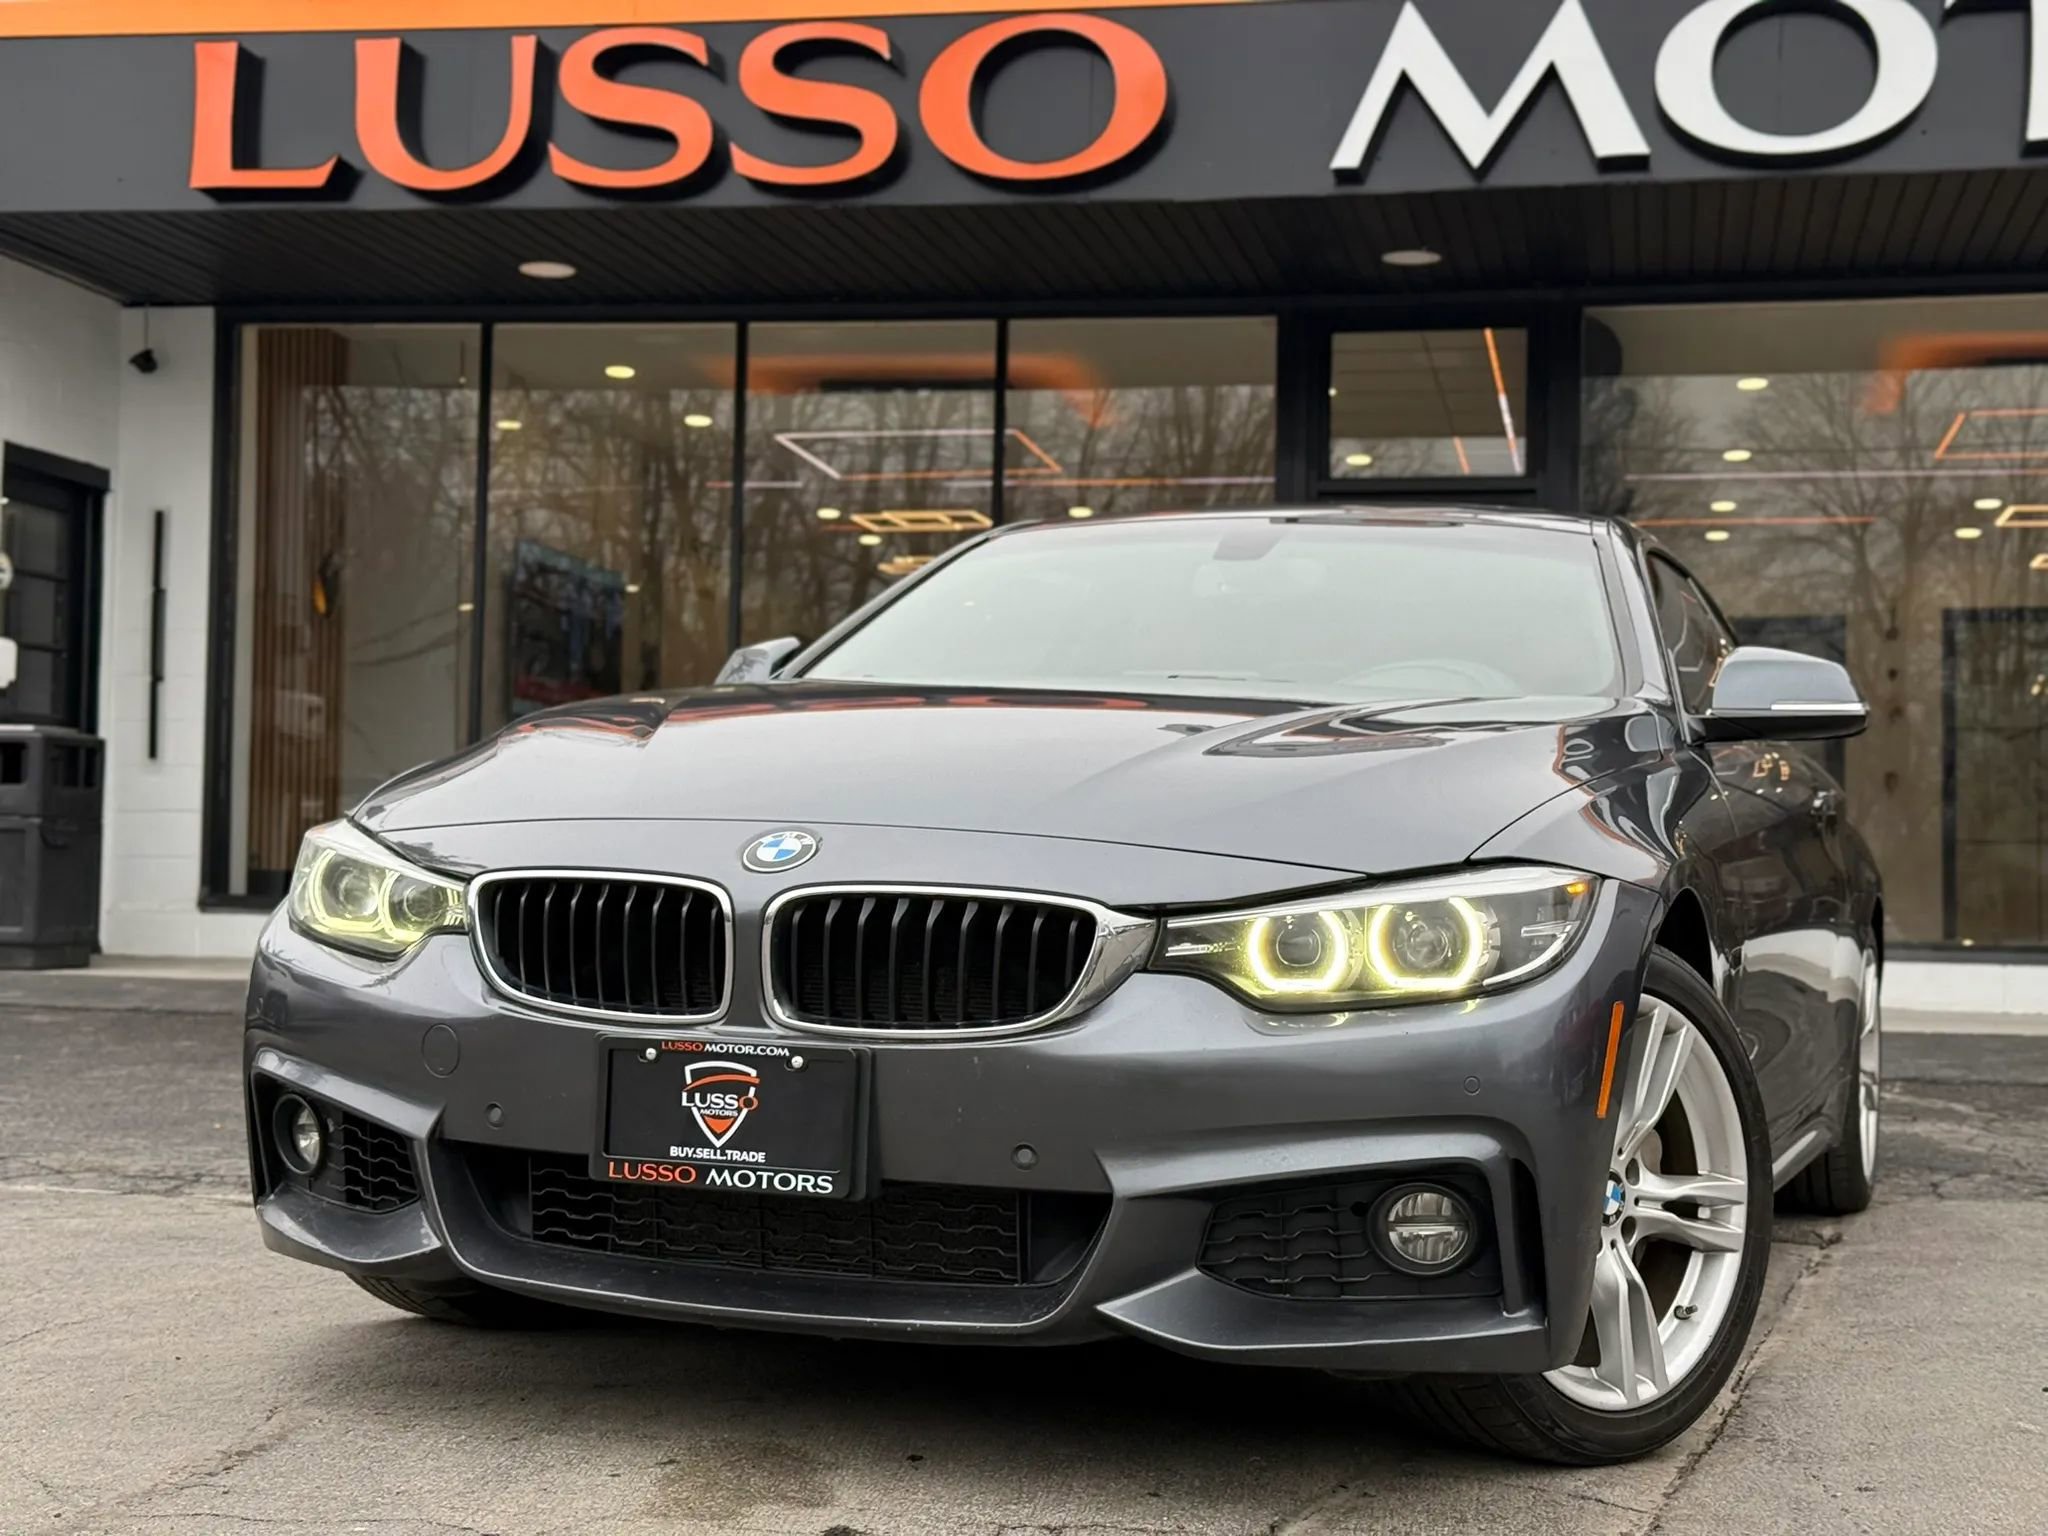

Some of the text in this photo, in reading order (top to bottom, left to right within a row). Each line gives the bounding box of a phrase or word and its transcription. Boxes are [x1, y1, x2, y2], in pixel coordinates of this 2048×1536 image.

[189, 0, 2048, 191] LUSSO MO
[661, 1040, 790, 1057] LUSSOMOTOR.COM
[681, 1091, 759, 1111] LUSSO
[700, 1108, 739, 1117] MOTORS
[608, 1161, 834, 1195] LUSSO MOTORS
